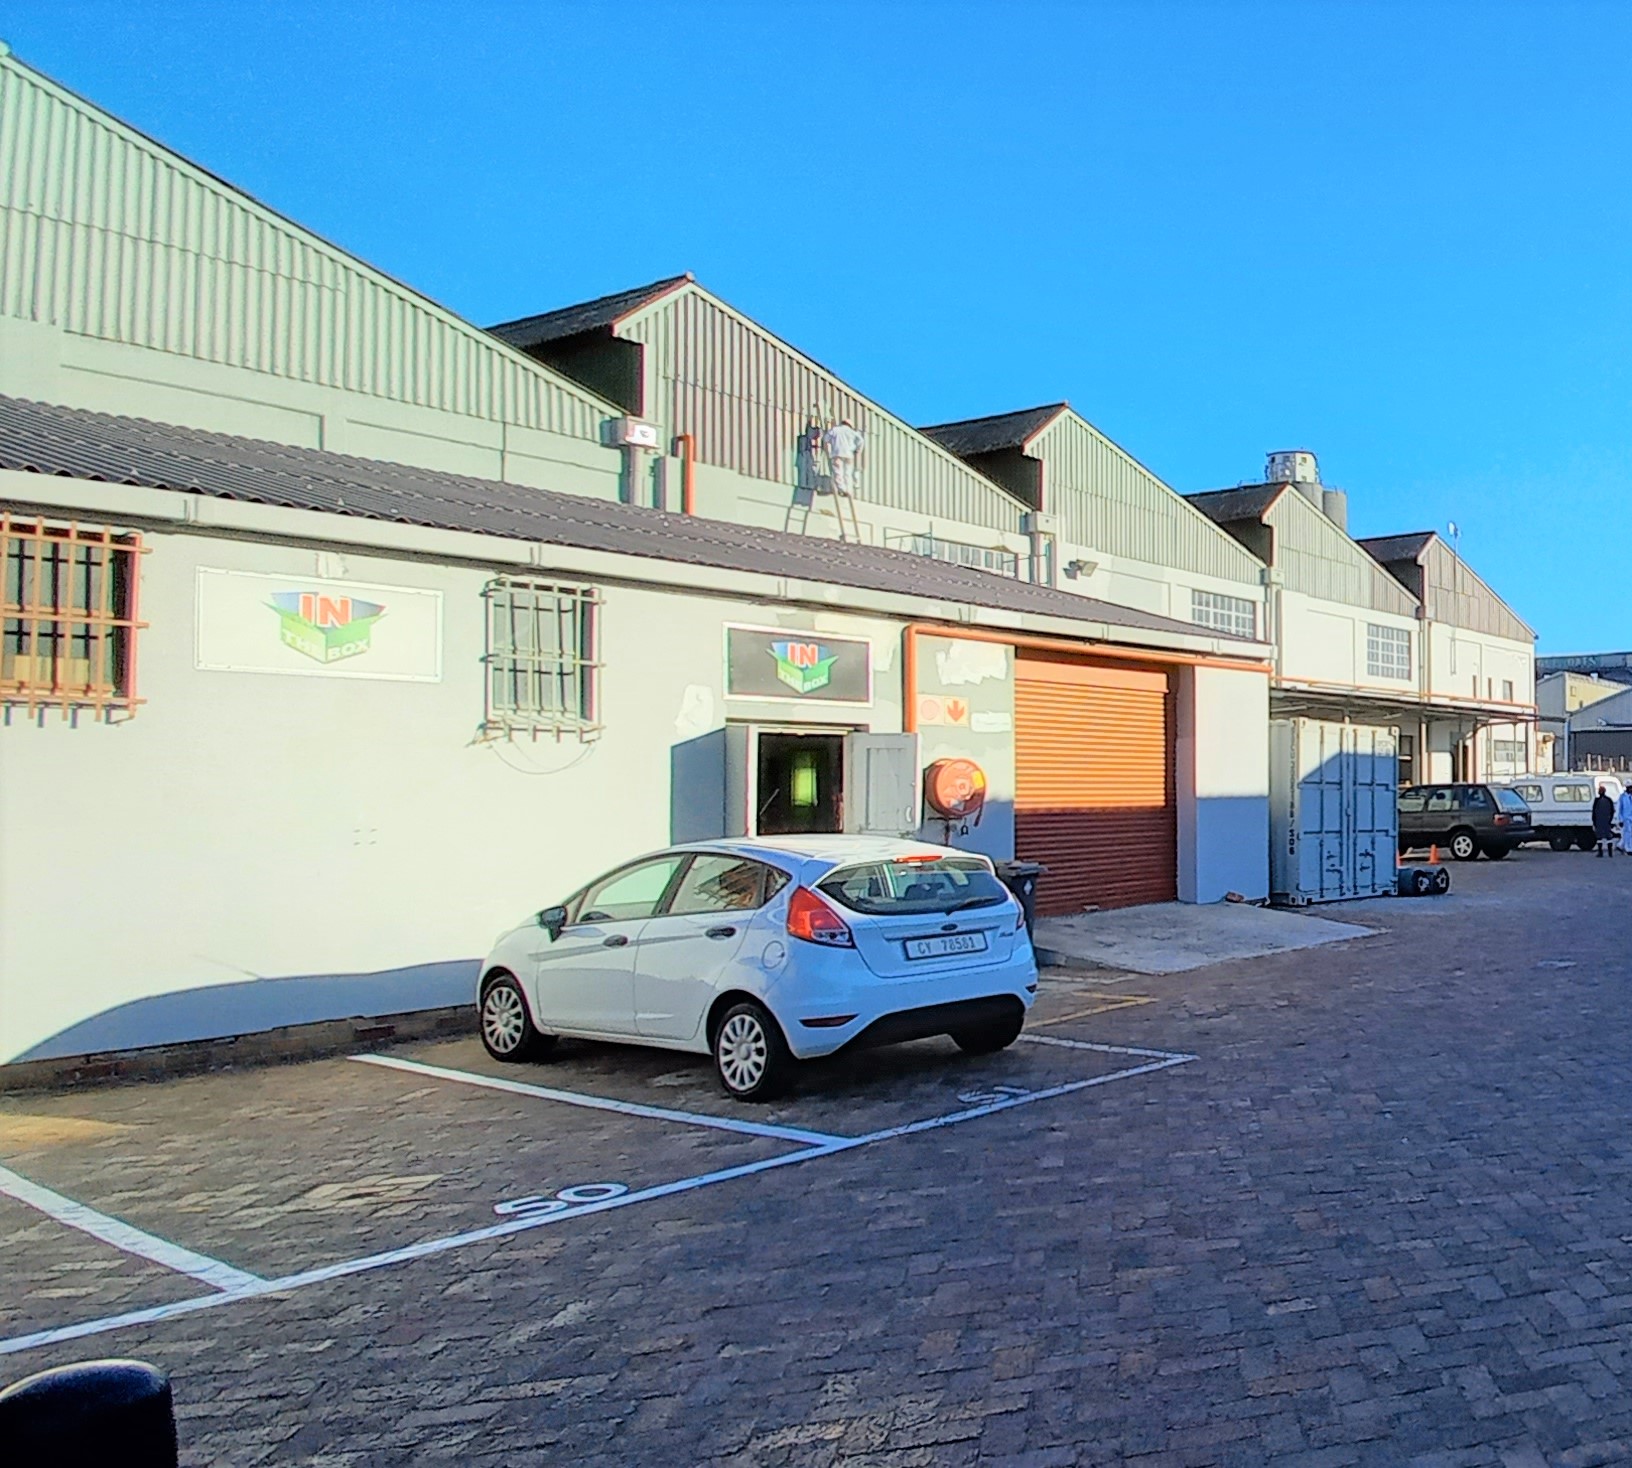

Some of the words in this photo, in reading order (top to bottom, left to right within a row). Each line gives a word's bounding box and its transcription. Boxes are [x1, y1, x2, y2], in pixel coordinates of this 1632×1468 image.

[299, 593, 352, 629] IN
[327, 637, 369, 660] BOX
[787, 641, 819, 669] IN
[917, 942, 931, 955] CY
[493, 1183, 629, 1219] 50
